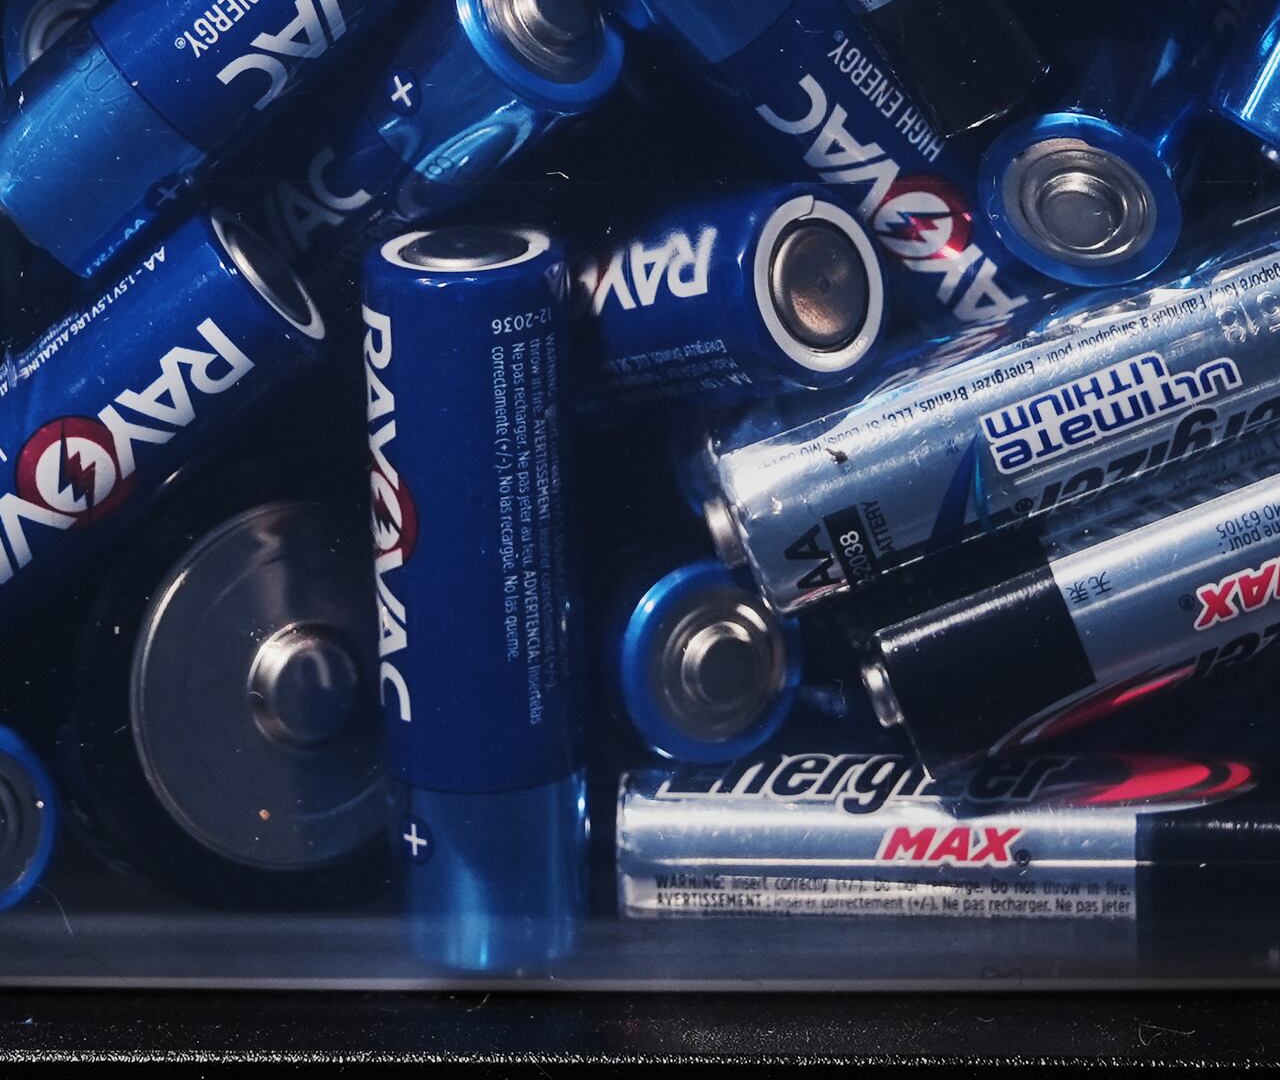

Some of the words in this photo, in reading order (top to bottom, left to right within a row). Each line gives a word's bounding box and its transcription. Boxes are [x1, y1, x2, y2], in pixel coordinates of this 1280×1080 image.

[891, 107, 949, 162] HIGH
[764, 73, 1028, 339] AYOVAC
[490, 307, 551, 334] 12-2036
[490, 346, 509, 435] correctamente
[983, 352, 1167, 440] LITHIUM
[992, 358, 1238, 473] ULTIMATE
[497, 475, 513, 493] No
[360, 303, 412, 723] RAYOVAC
[498, 496, 514, 513] las
[498, 515, 516, 573] recargue.
[1223, 523, 1262, 553] pour
[502, 575, 518, 592] No
[1063, 569, 1114, 605] 无汞
[503, 595, 519, 613] las
[503, 615, 521, 661] queme.
[882, 828, 1018, 861] MAX
[943, 898, 958, 911] Ne
[963, 900, 984, 913] pas
[988, 898, 1050, 913] recharger.
[1056, 898, 1071, 911] Ne
[1076, 900, 1097, 913] pas
[1102, 898, 1129, 913] jeter
